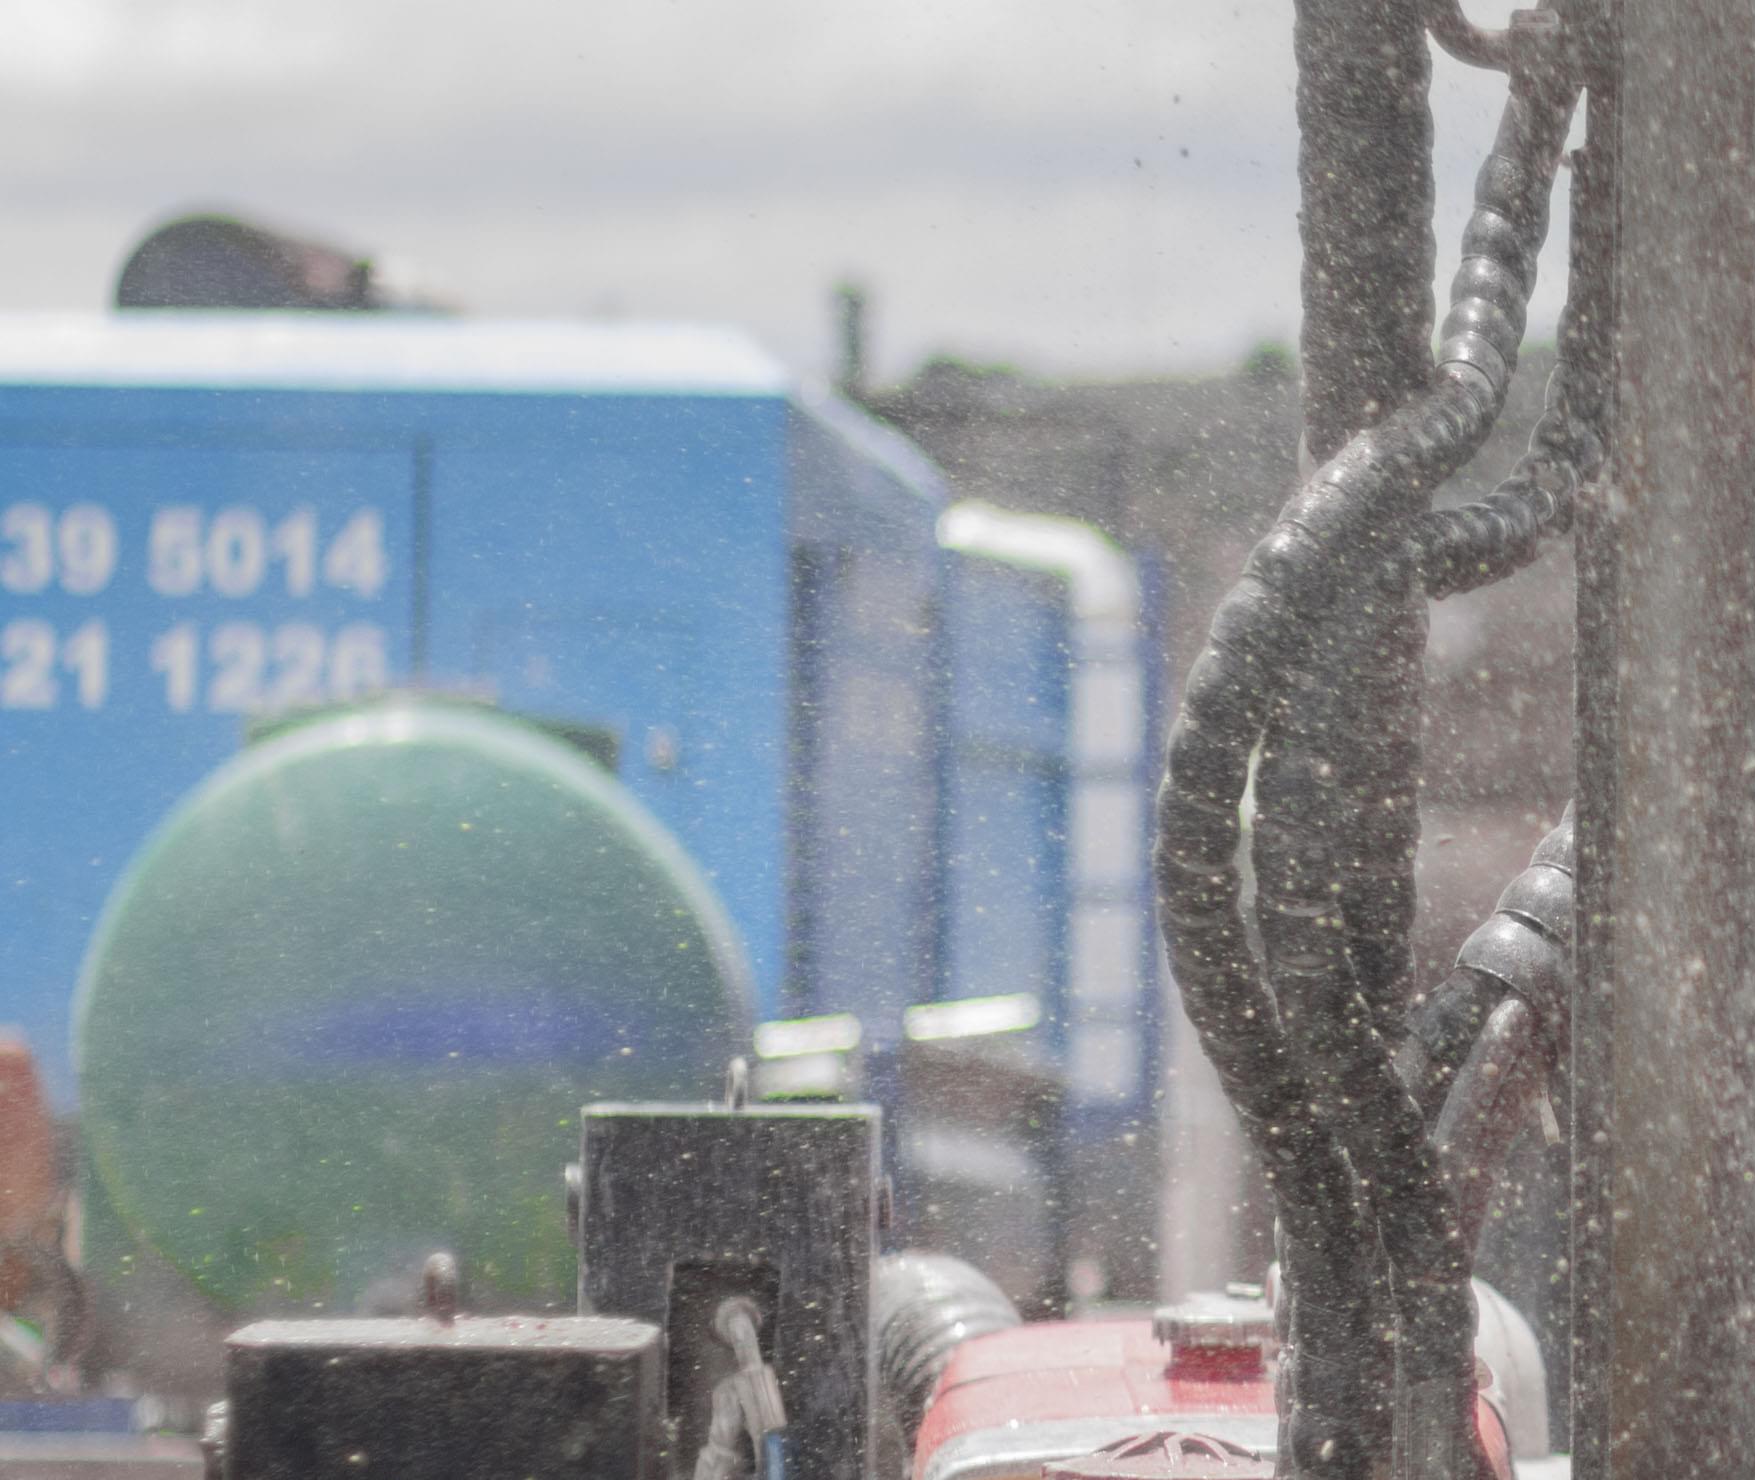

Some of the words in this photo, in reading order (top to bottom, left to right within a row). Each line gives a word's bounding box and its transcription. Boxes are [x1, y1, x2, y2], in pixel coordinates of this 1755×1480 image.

[0, 503, 117, 596] 39
[148, 506, 388, 598] 5014
[0, 621, 108, 710] 21
